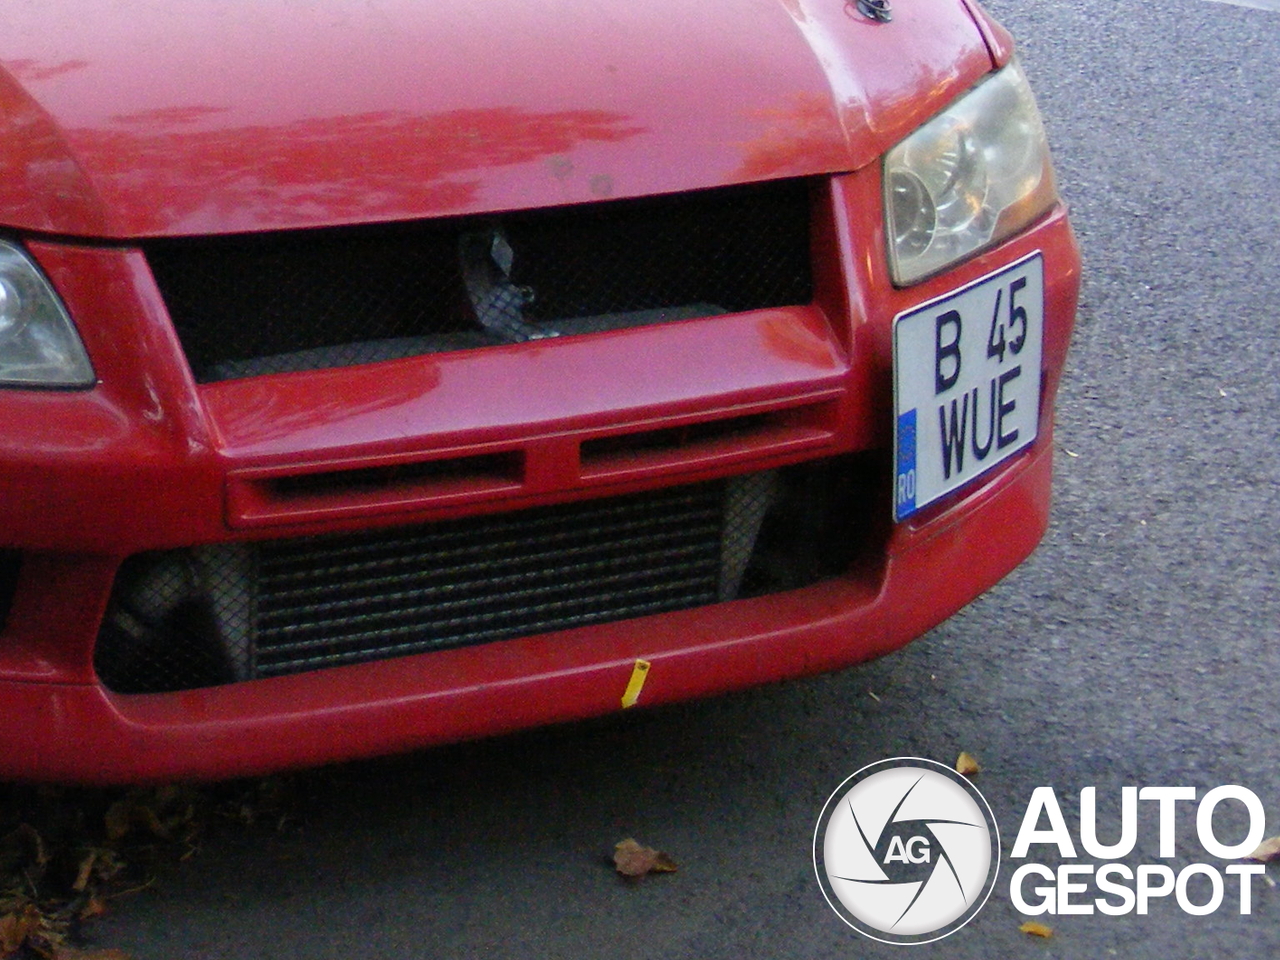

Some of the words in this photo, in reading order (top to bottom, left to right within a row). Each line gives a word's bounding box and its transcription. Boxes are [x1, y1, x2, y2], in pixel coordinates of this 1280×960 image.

[935, 309, 962, 395] B
[987, 276, 1028, 364] 45
[939, 364, 1021, 480] WUE
[898, 469, 915, 505] RO
